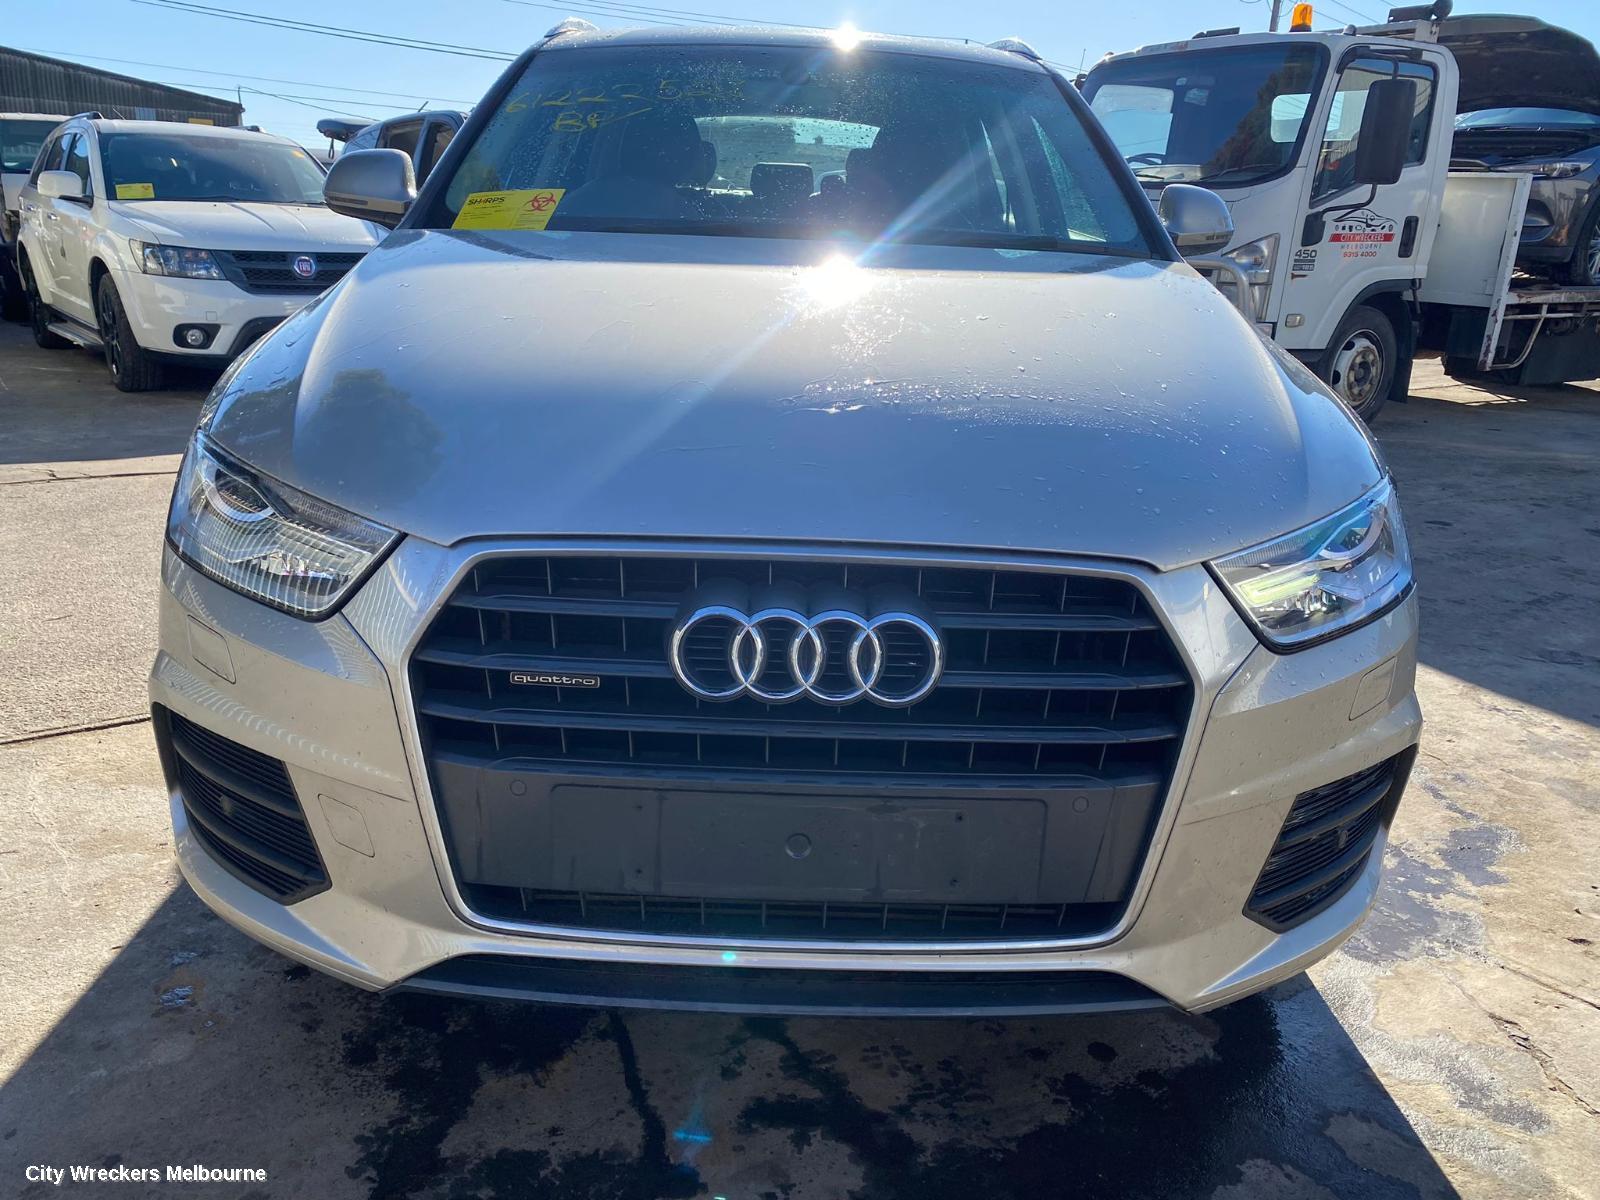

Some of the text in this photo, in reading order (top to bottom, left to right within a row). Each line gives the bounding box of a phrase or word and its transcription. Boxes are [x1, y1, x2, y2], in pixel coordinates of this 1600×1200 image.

[1354, 233, 1385, 242] WRECKERS
[1294, 249, 1318, 259] 450
[514, 675, 595, 685] quattro
